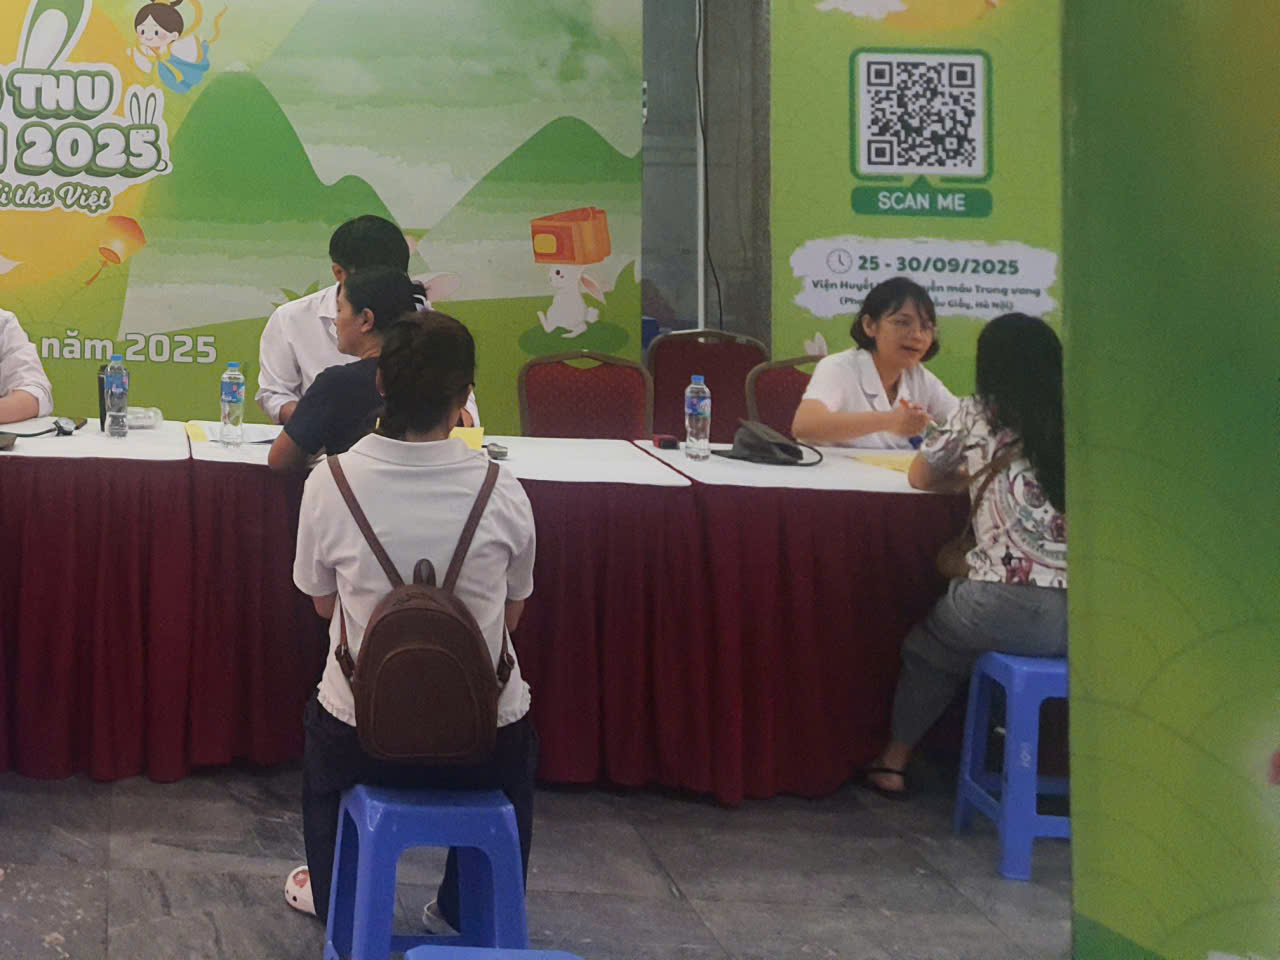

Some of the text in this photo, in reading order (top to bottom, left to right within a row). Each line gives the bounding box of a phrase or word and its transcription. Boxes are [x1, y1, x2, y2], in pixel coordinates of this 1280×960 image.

[8, 68, 114, 120] THU
[14, 121, 163, 178] 2025
[14, 182, 54, 206] thơ
[58, 186, 113, 212] Việt
[878, 192, 966, 211] SCAN ME
[858, 255, 880, 271] 25
[897, 256, 1019, 275] 30/09/2025
[41, 329, 114, 360] năm
[125, 333, 217, 364] 2025
